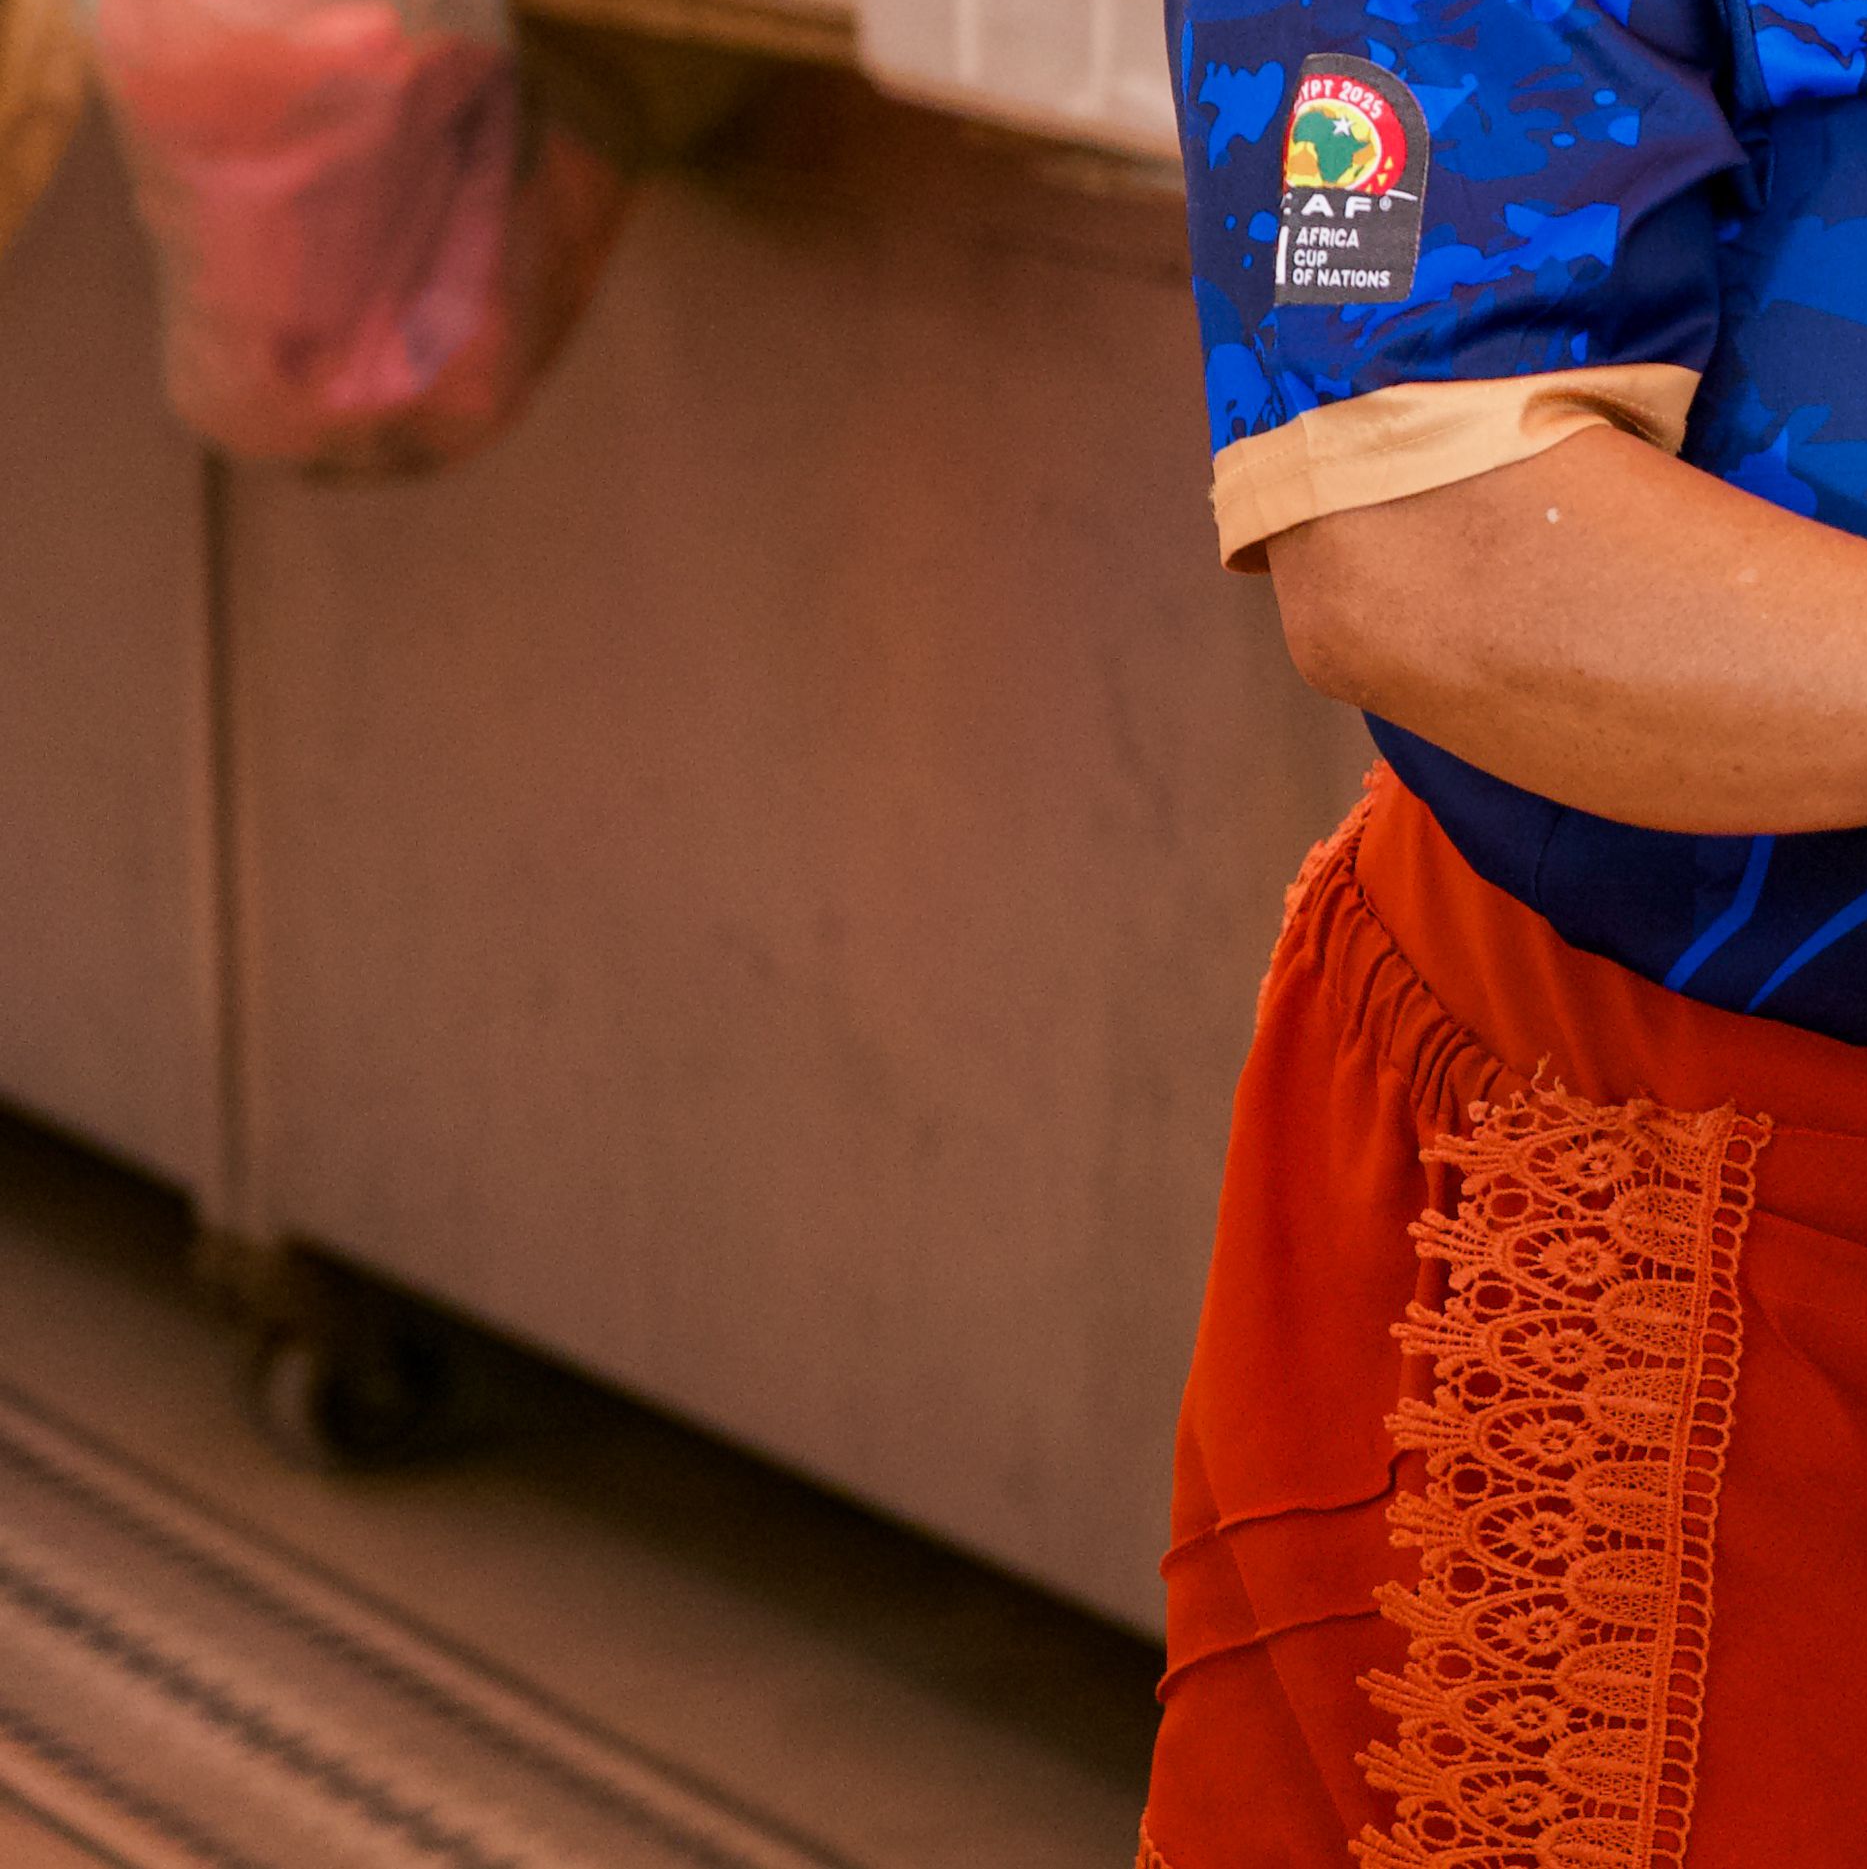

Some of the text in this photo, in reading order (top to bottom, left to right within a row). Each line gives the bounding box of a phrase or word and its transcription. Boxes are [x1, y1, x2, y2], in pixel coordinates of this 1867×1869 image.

[1338, 81, 1384, 120] 2025
[1295, 226, 1360, 248] AFRICA
[1293, 249, 1328, 267] CUP
[1292, 268, 1392, 288] OF NATIONS
